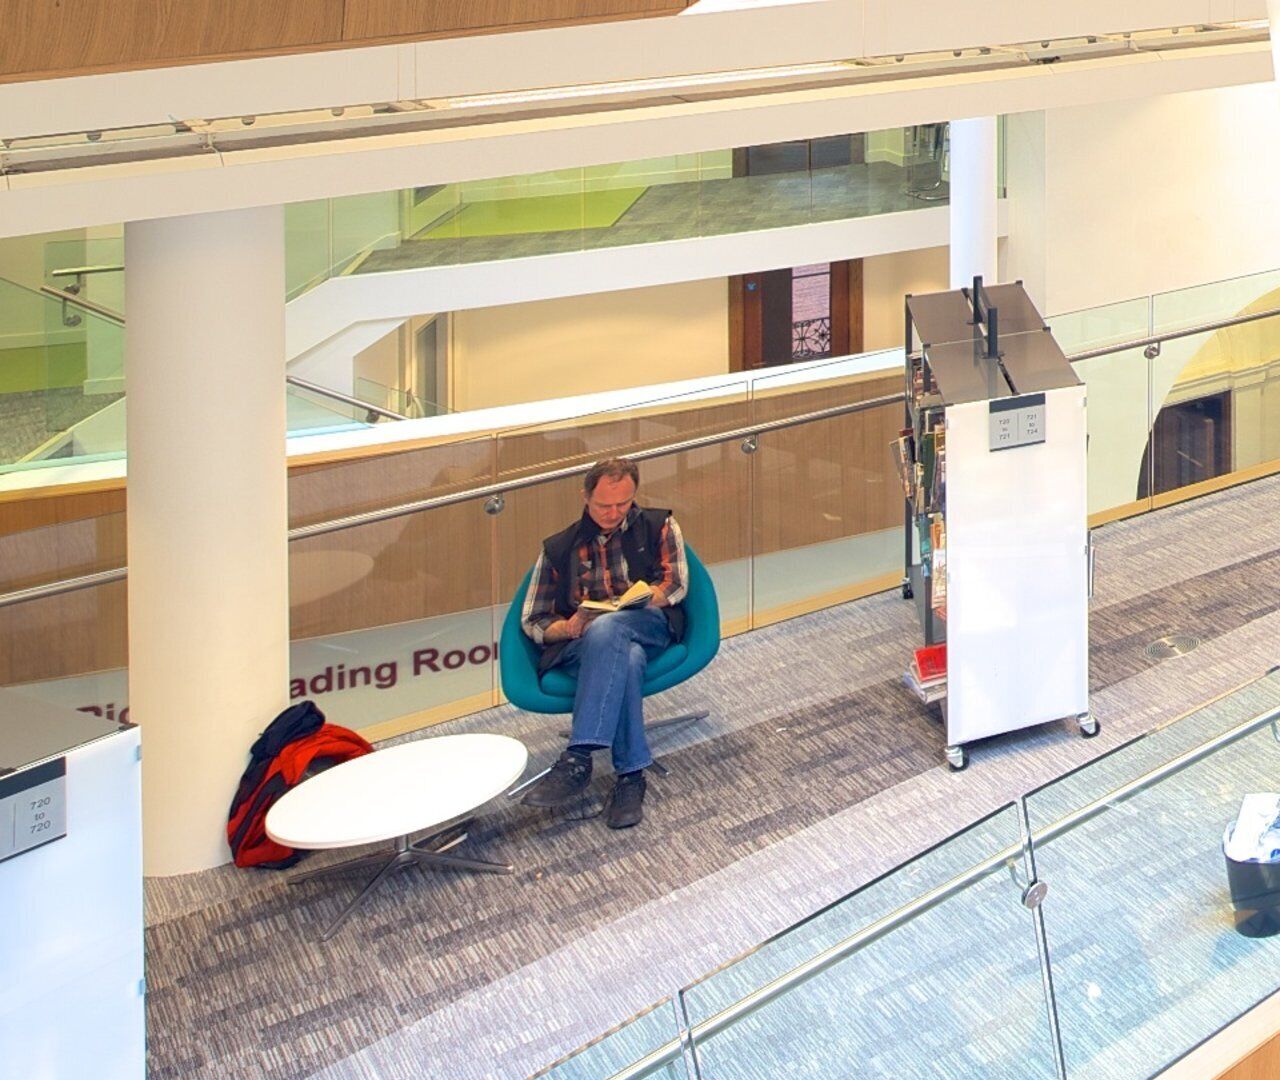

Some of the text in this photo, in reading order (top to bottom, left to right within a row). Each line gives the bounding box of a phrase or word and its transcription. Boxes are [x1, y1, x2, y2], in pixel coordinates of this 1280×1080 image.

[290, 642, 498, 699] ading Roo
[30, 797, 51, 810] 720
[34, 812, 45, 820] to
[30, 820, 51, 834] 720
